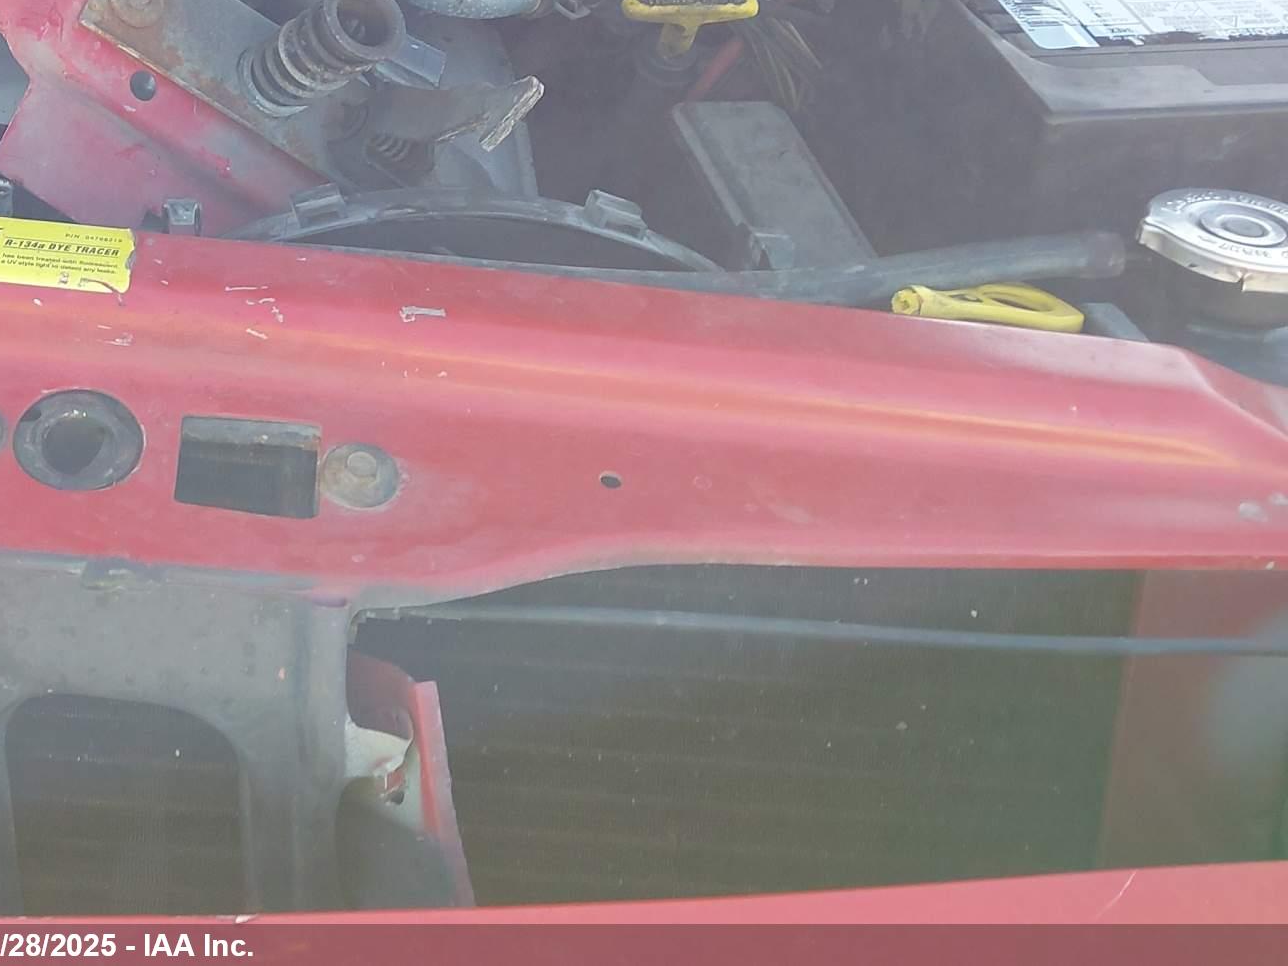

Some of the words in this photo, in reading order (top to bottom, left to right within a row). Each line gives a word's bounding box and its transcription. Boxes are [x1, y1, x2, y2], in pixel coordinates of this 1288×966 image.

[4, 238, 45, 249] R-134a
[48, 242, 72, 252] DYE
[75, 245, 120, 256] TRACER
